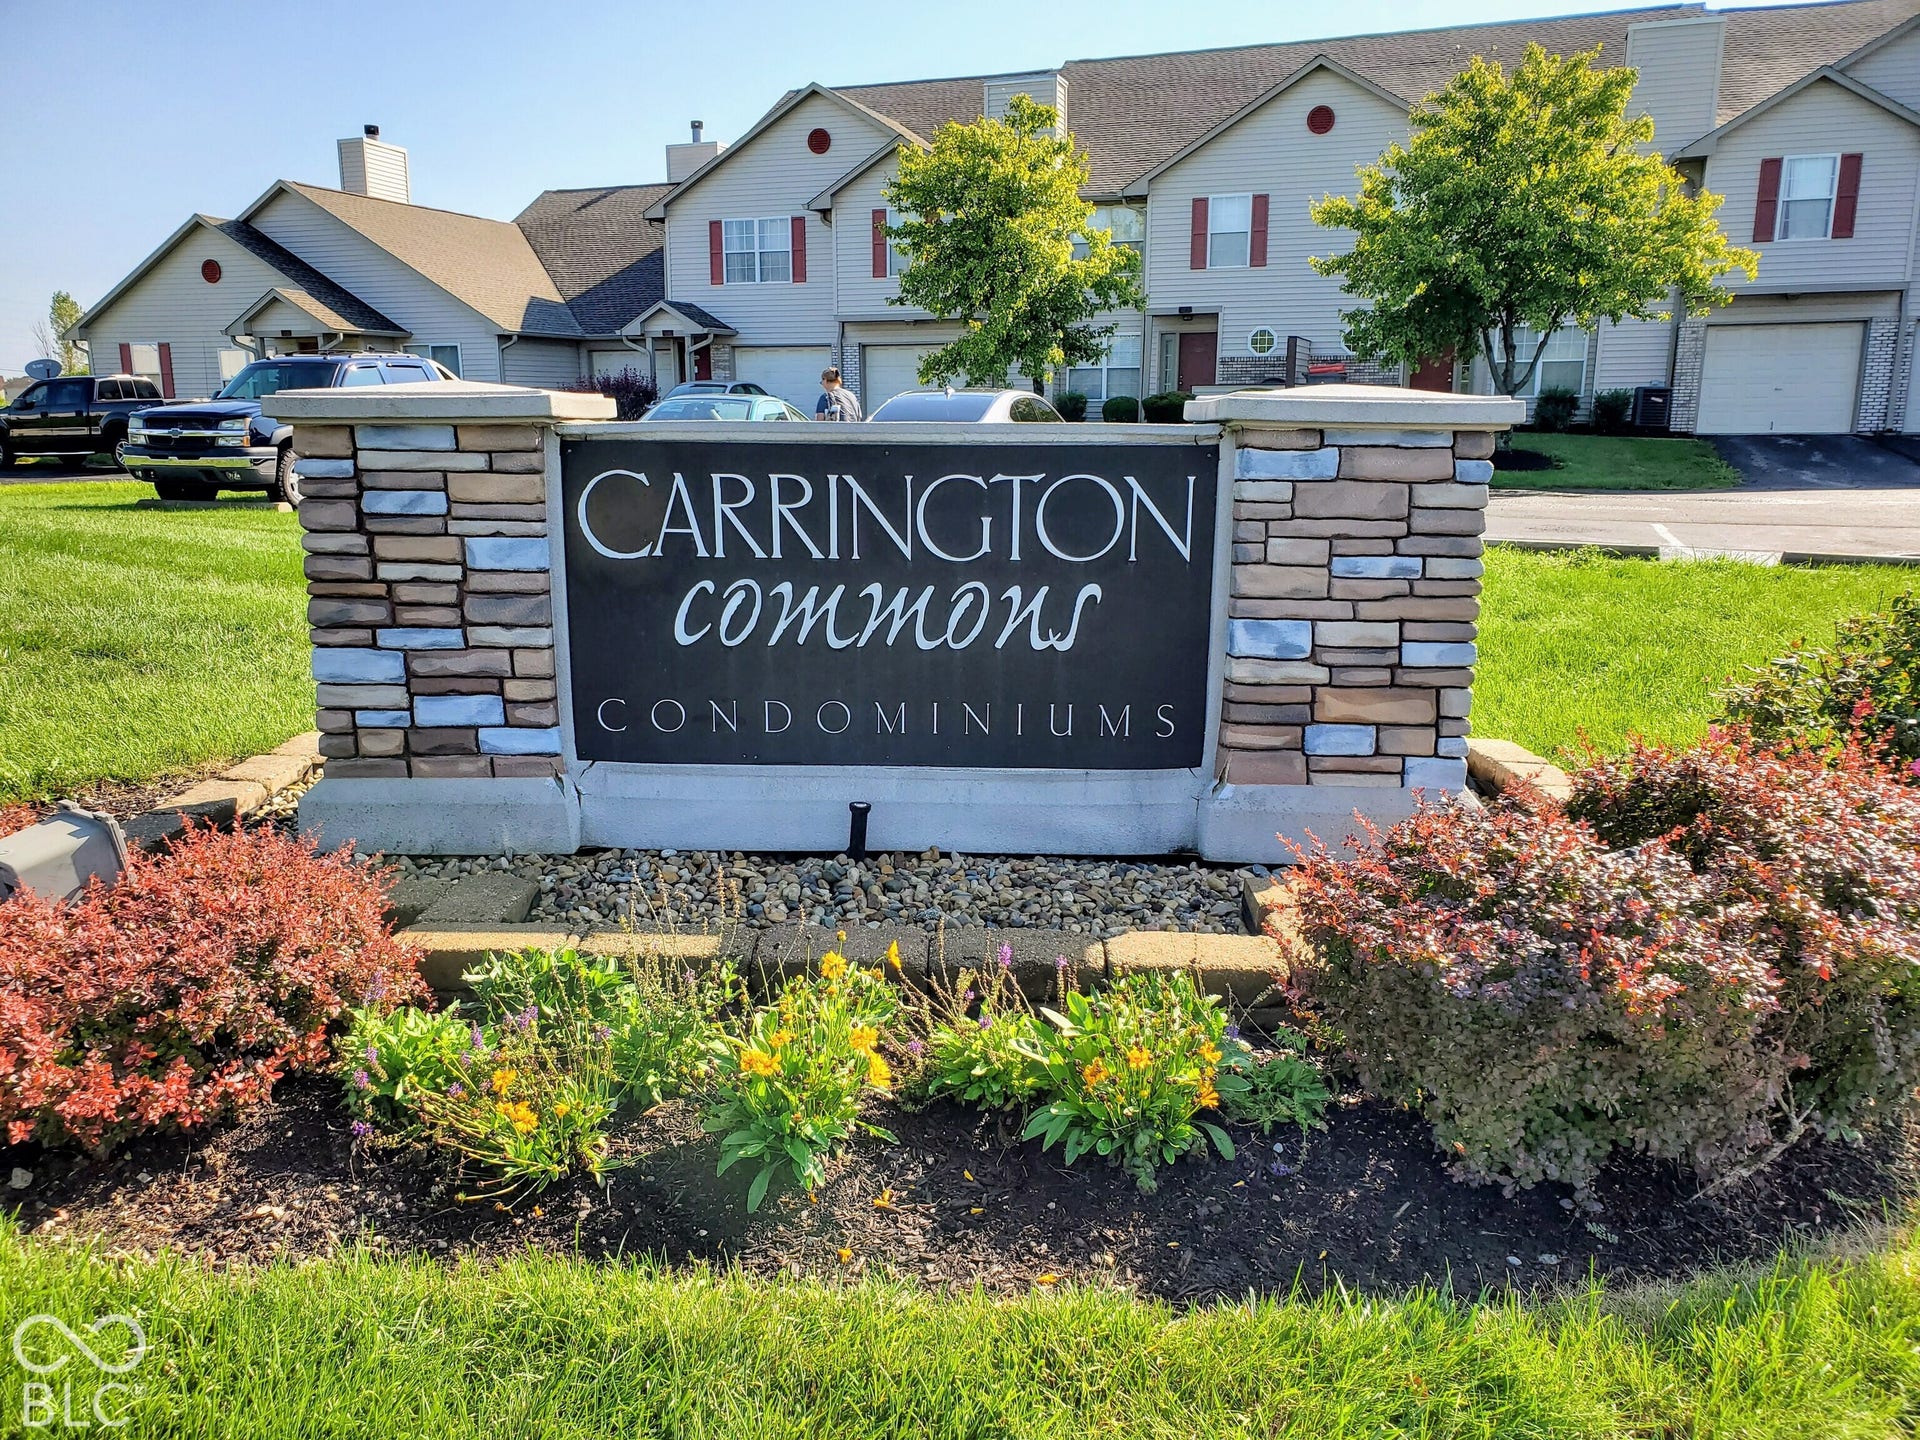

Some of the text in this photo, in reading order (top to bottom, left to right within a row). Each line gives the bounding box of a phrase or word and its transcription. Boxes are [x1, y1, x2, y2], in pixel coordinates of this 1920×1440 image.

[576, 469, 1196, 563] CARRINGTON
[674, 578, 1103, 652] commons
[597, 698, 1176, 738] CONDOMINIUMS
